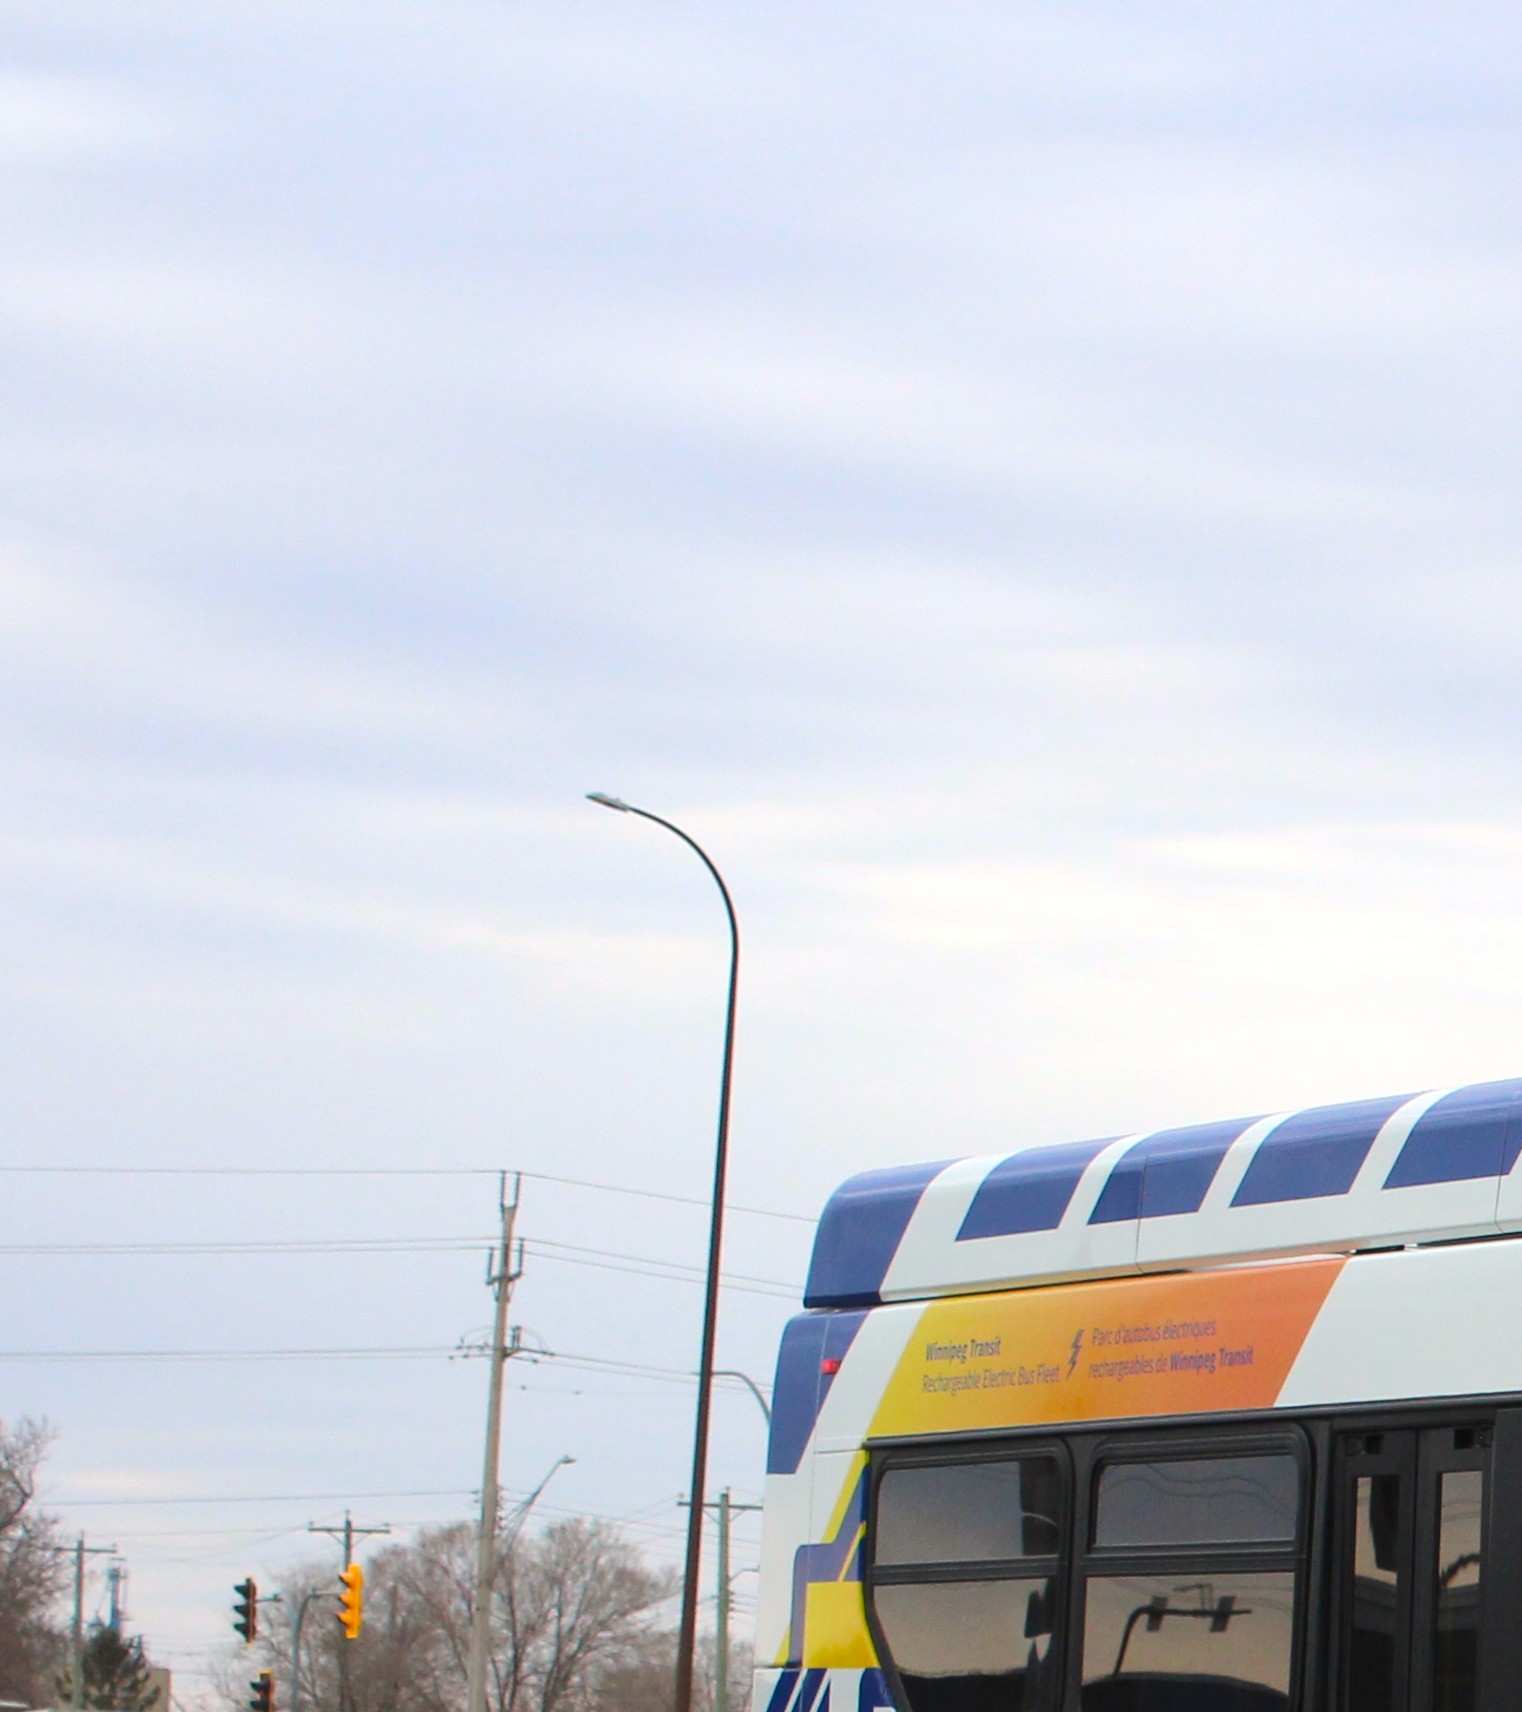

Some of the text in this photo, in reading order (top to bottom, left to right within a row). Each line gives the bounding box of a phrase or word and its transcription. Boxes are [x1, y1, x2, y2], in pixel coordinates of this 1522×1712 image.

[1092, 1319, 1217, 1346] Parc d'autobus électriques
[926, 1336, 1001, 1364] Winnipeg Transit
[1089, 1345, 1254, 1382] rechargeables de Winnipeg Transit
[922, 1363, 1060, 1396] Rechargeable Electric Bus Fleet
